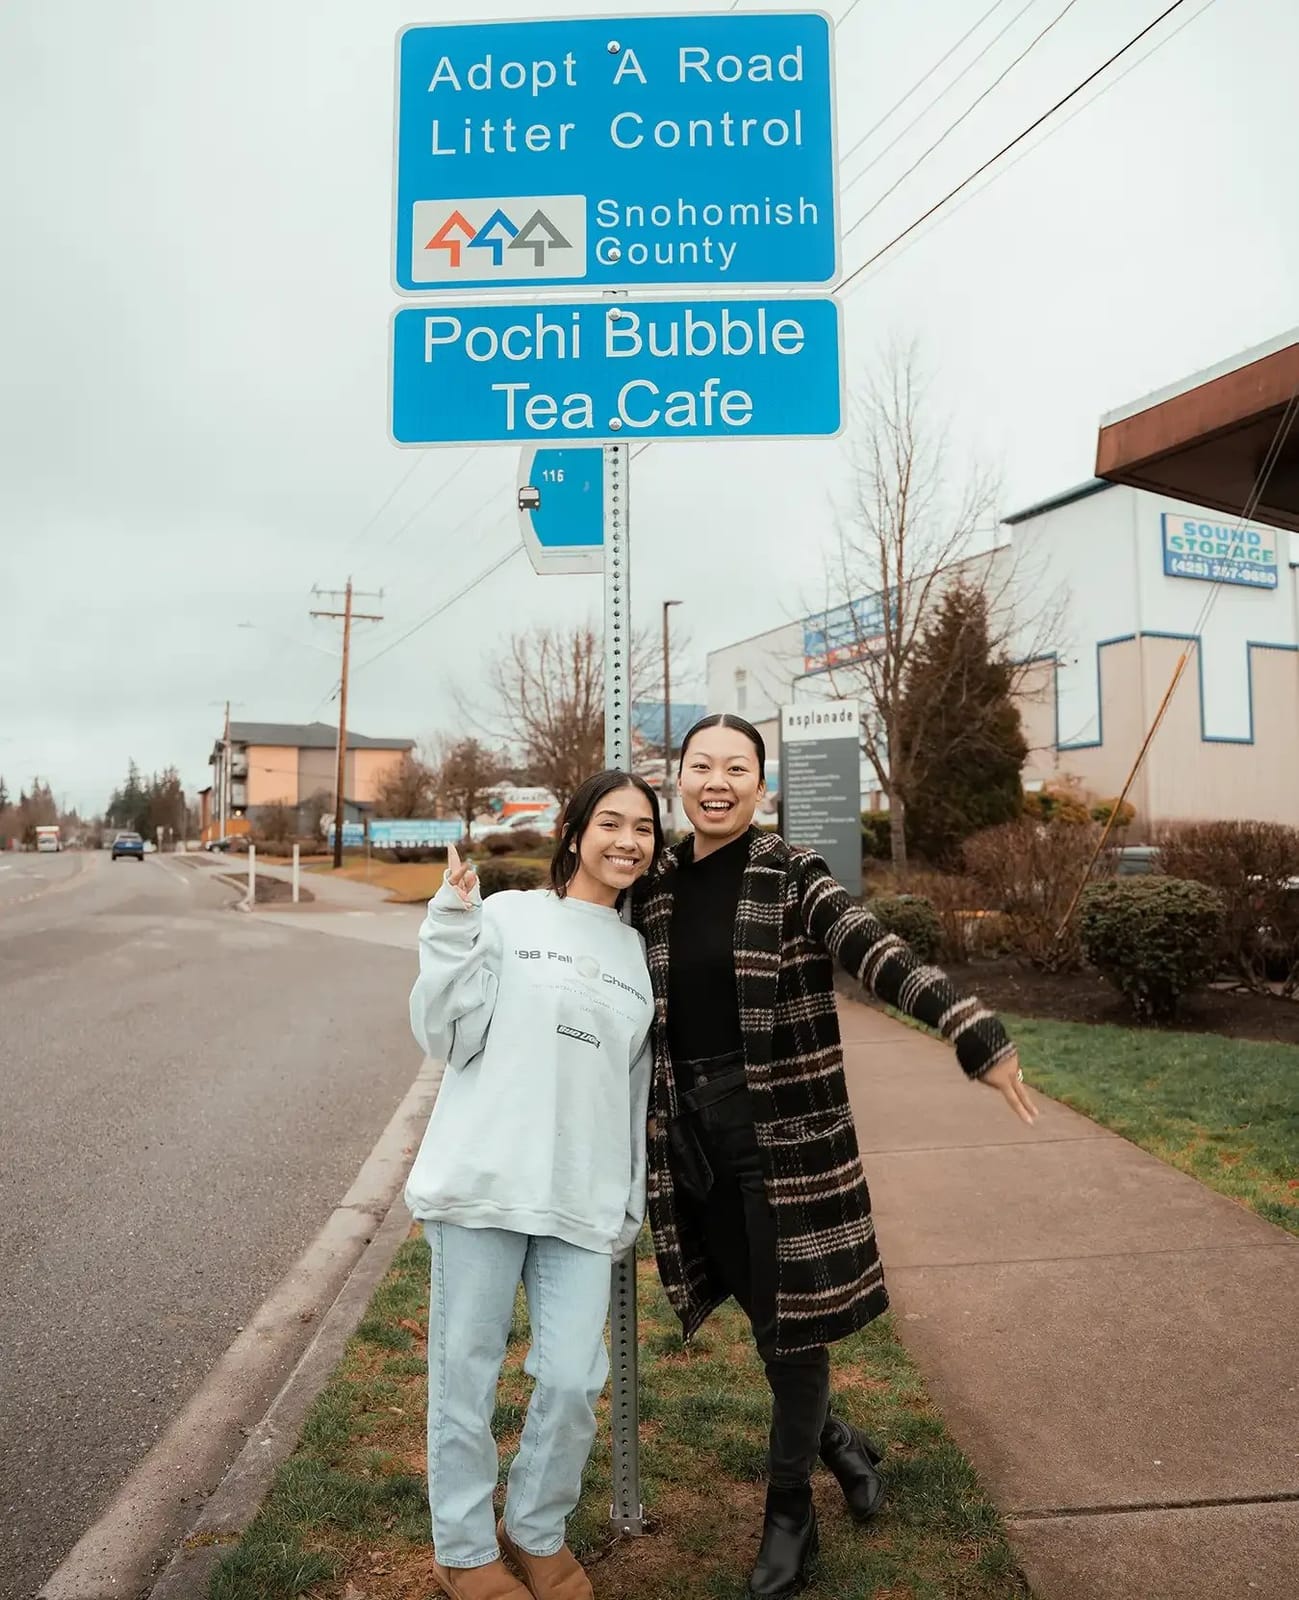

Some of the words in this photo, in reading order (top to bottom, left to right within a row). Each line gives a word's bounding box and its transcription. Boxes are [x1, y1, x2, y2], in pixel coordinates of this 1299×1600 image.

[428, 51, 577, 97] Adopt
[613, 48, 648, 84] A
[678, 45, 803, 83] Road
[431, 117, 576, 155] Litter
[610, 110, 803, 149] Control
[596, 197, 819, 228] Snohomish
[595, 236, 737, 271] County
[424, 312, 581, 363] Pochi
[605, 308, 805, 358] Bubble
[491, 382, 594, 431] Tea
[617, 378, 753, 428] Cafe
[542, 469, 565, 482] 116
[1170, 535, 1274, 562] STORAGE
[1183, 522, 1261, 545] SOUND
[788, 708, 853, 728] esplanade
[514, 949, 541, 959] '98
[547, 951, 573, 964] Fall
